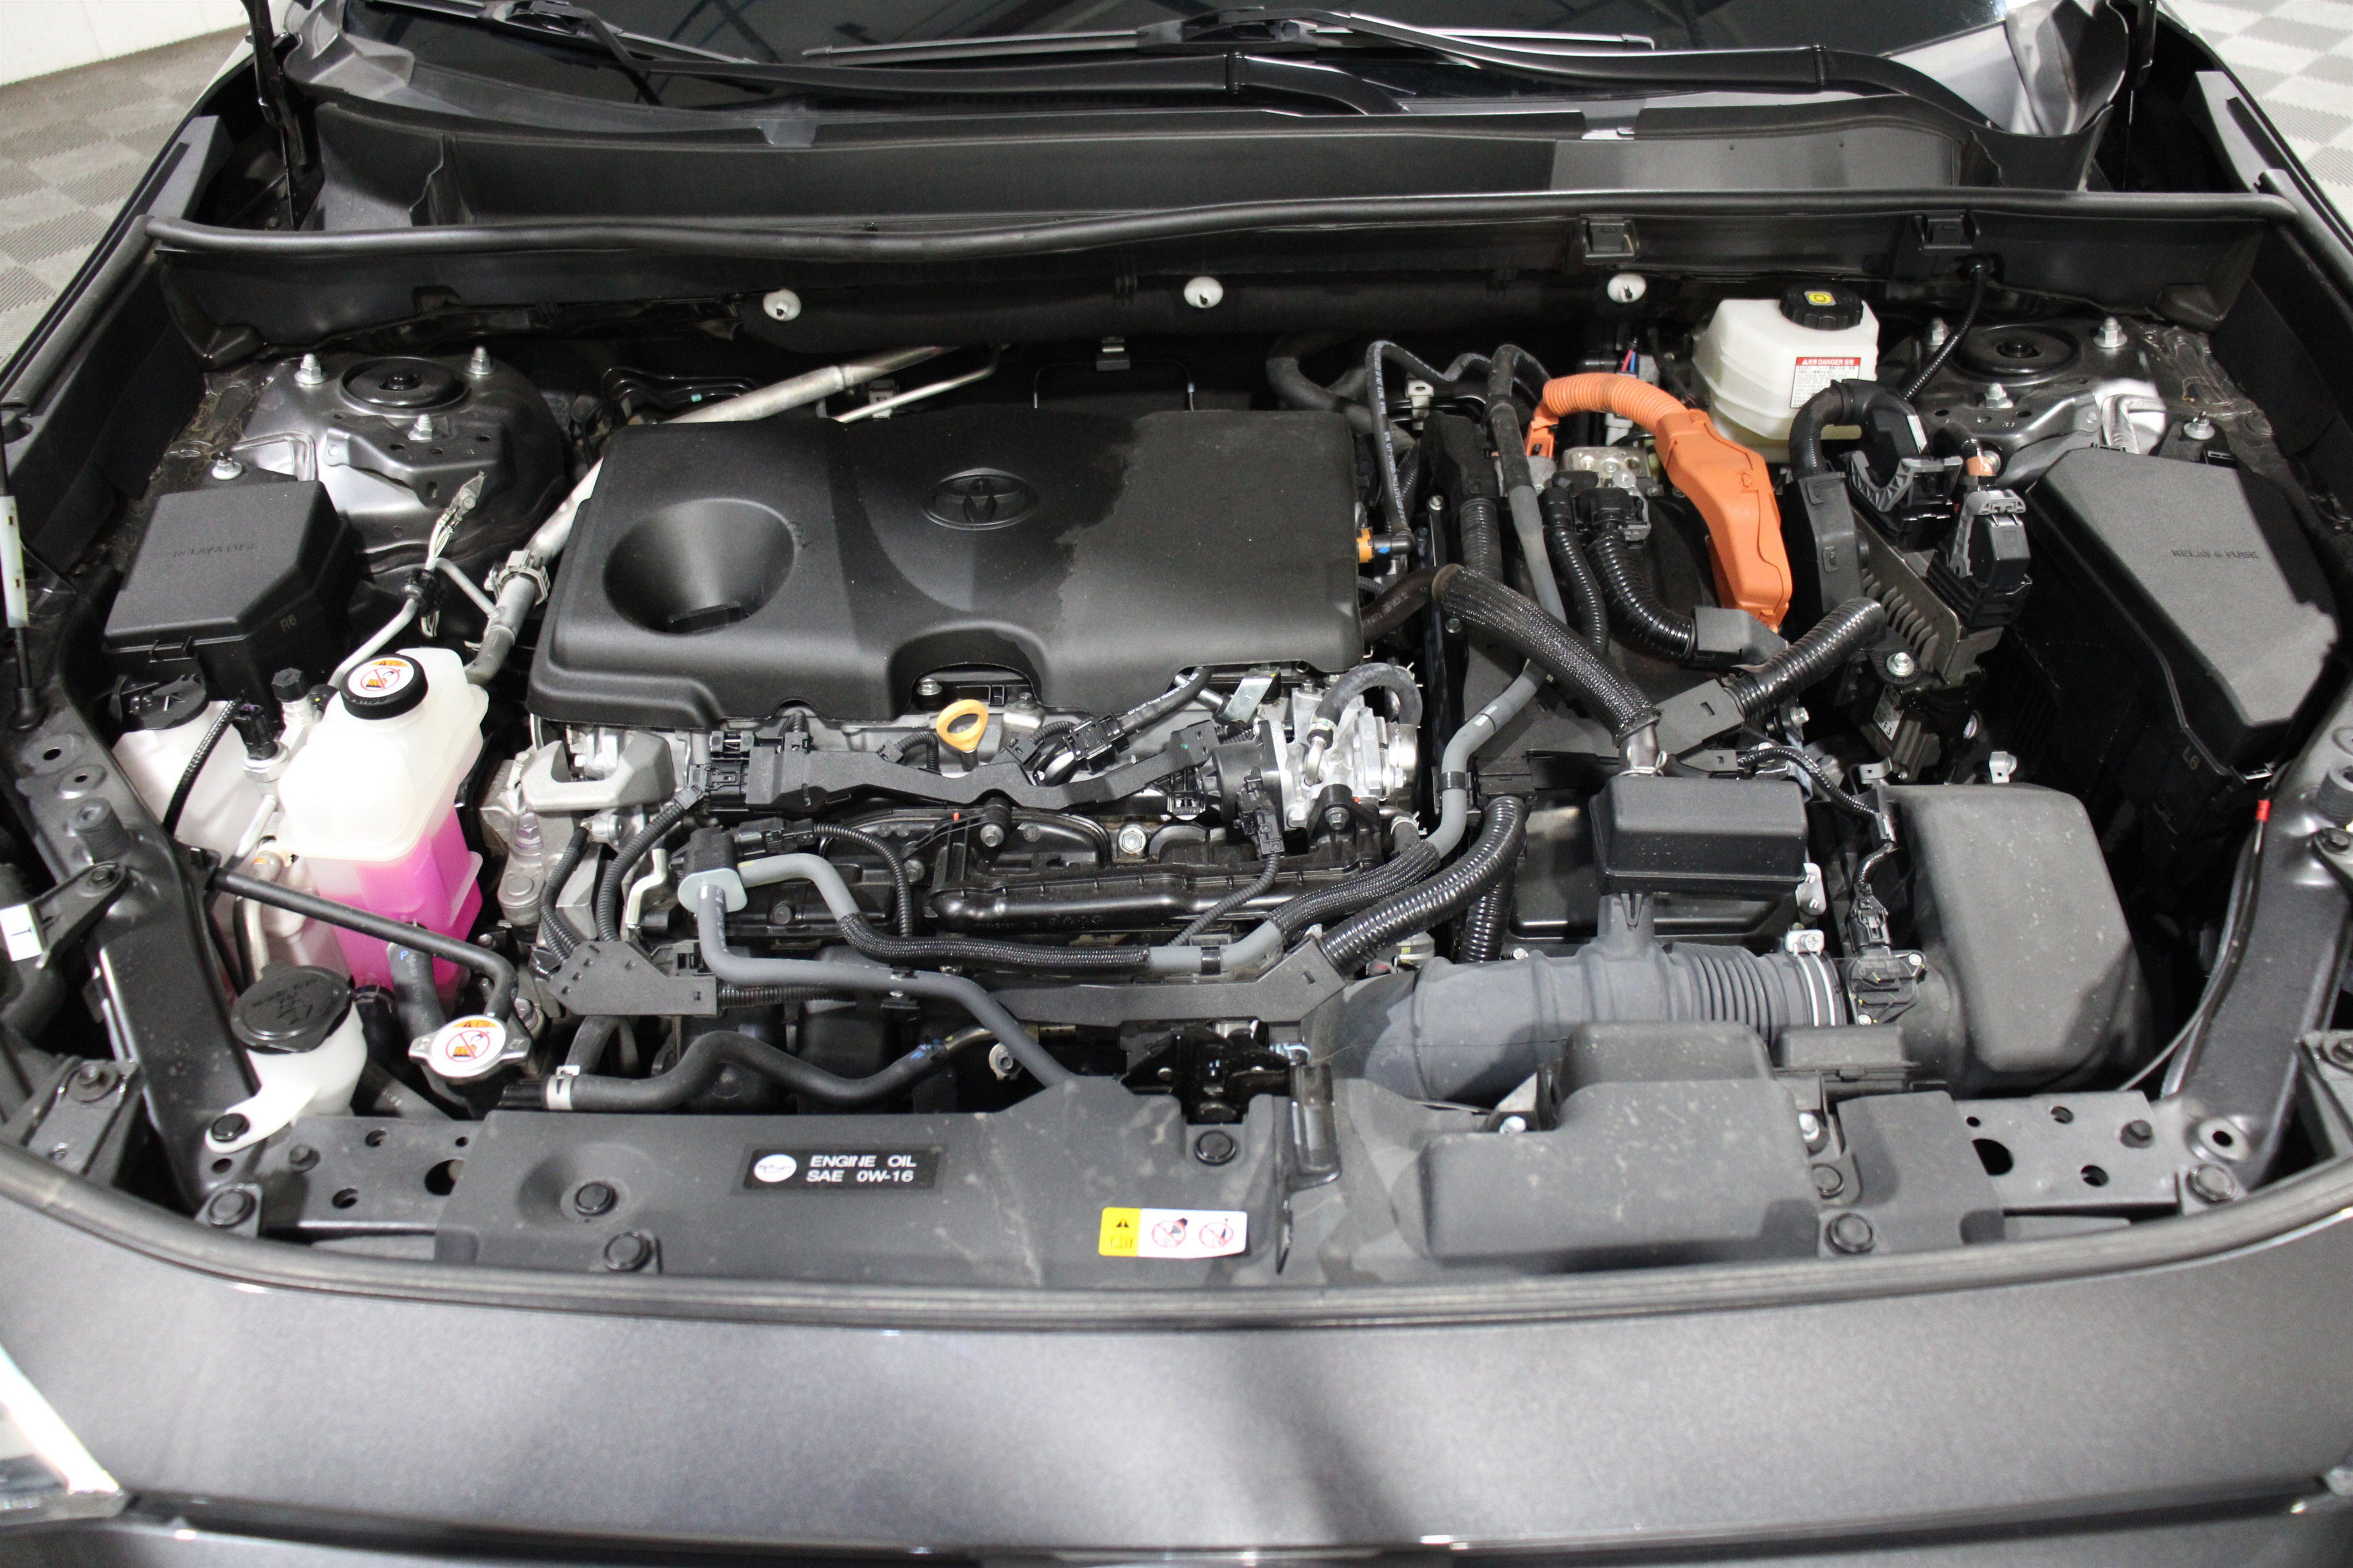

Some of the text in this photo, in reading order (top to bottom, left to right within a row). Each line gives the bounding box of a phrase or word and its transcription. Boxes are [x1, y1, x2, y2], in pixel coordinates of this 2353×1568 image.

[2171, 549, 2211, 558] RELAY
[2224, 550, 2259, 558] FUSE
[280, 613, 297, 633] R6
[2182, 745, 2200, 770] L6
[810, 1155, 917, 1168] ENGINE OIL
[806, 1170, 914, 1183] SAE 0W-16
